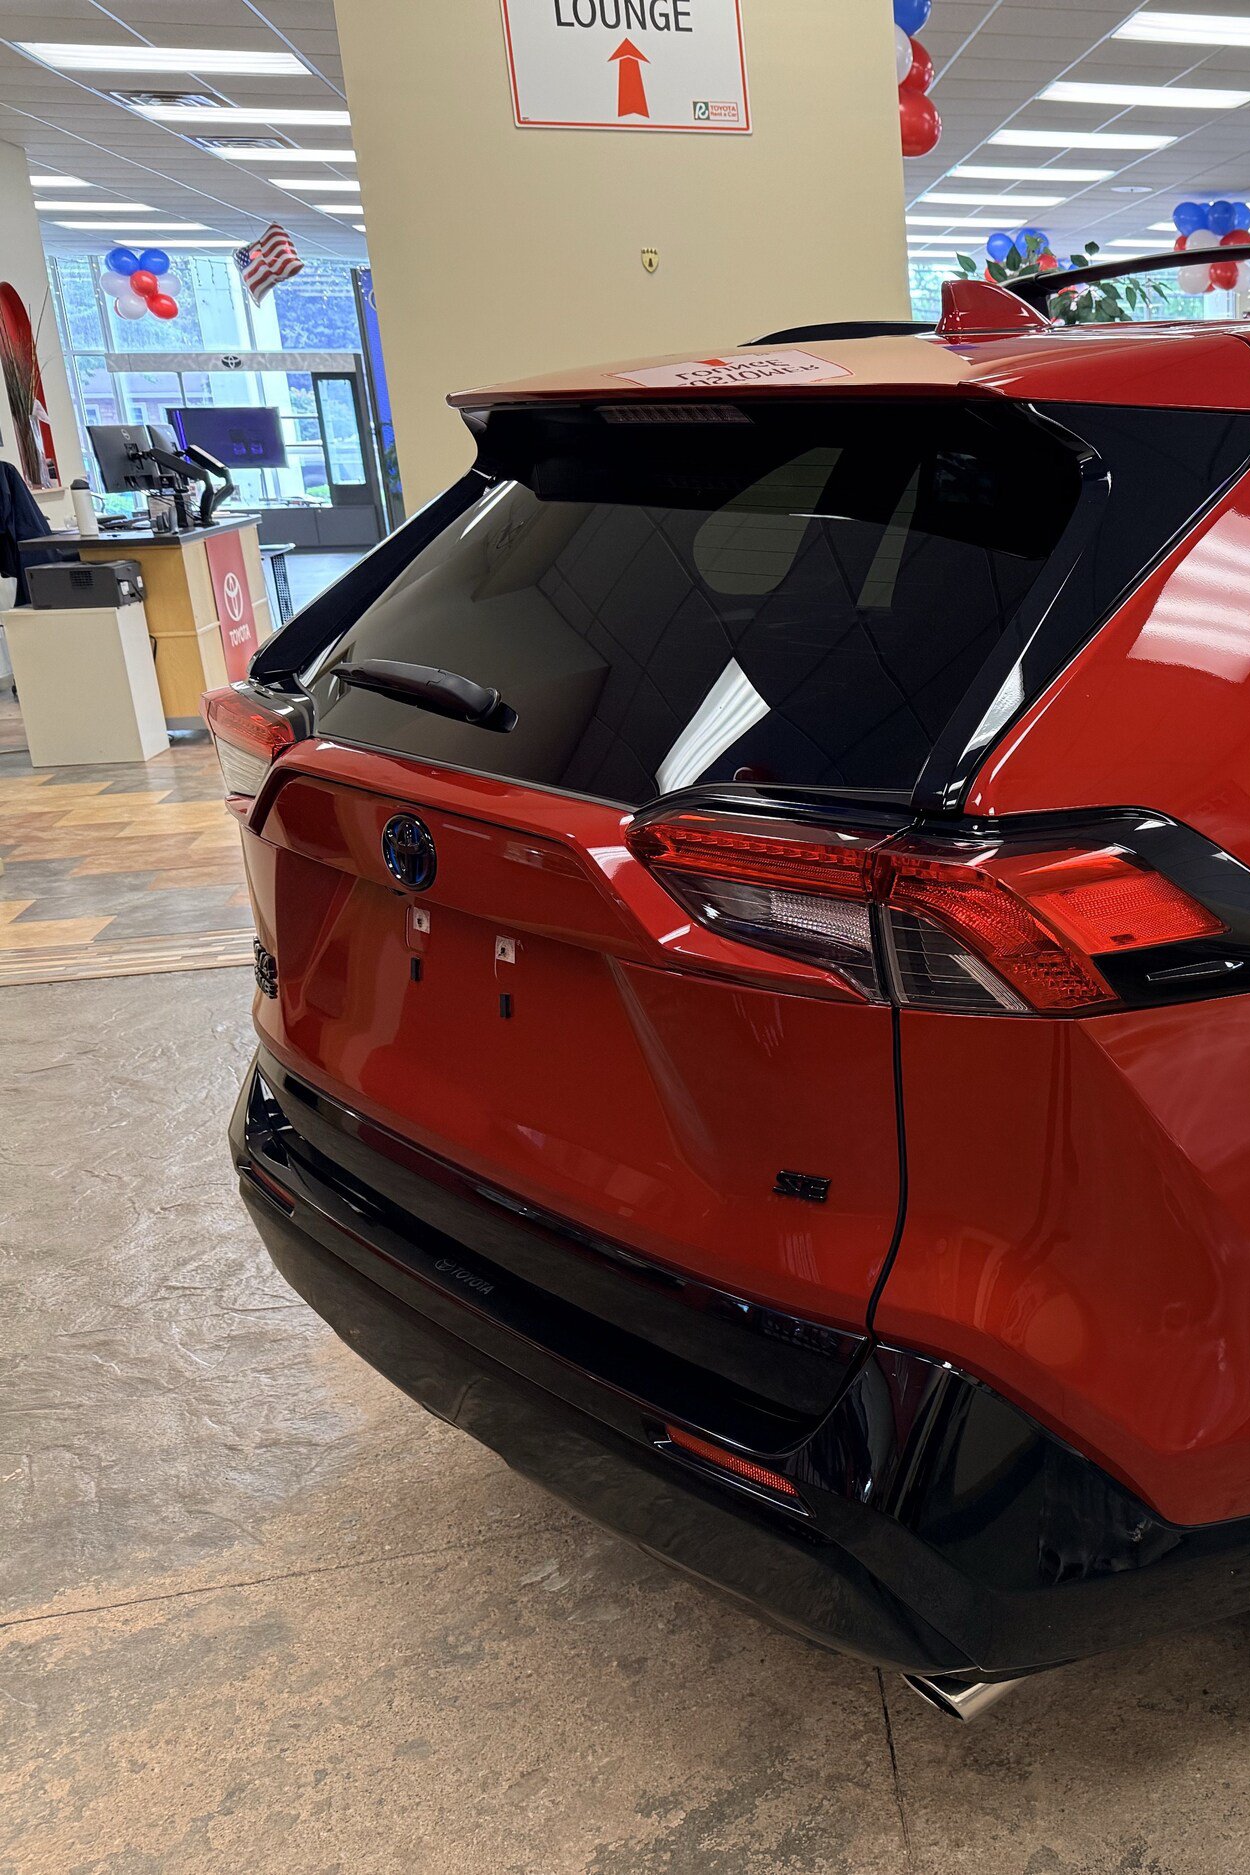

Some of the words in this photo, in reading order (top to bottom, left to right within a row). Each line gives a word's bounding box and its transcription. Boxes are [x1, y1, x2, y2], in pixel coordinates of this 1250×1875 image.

[553, 0, 693, 32] LOUNGE
[229, 623, 251, 647] TOYOTA
[772, 1169, 832, 1203] SE
[450, 1267, 494, 1295] TOYOTA
